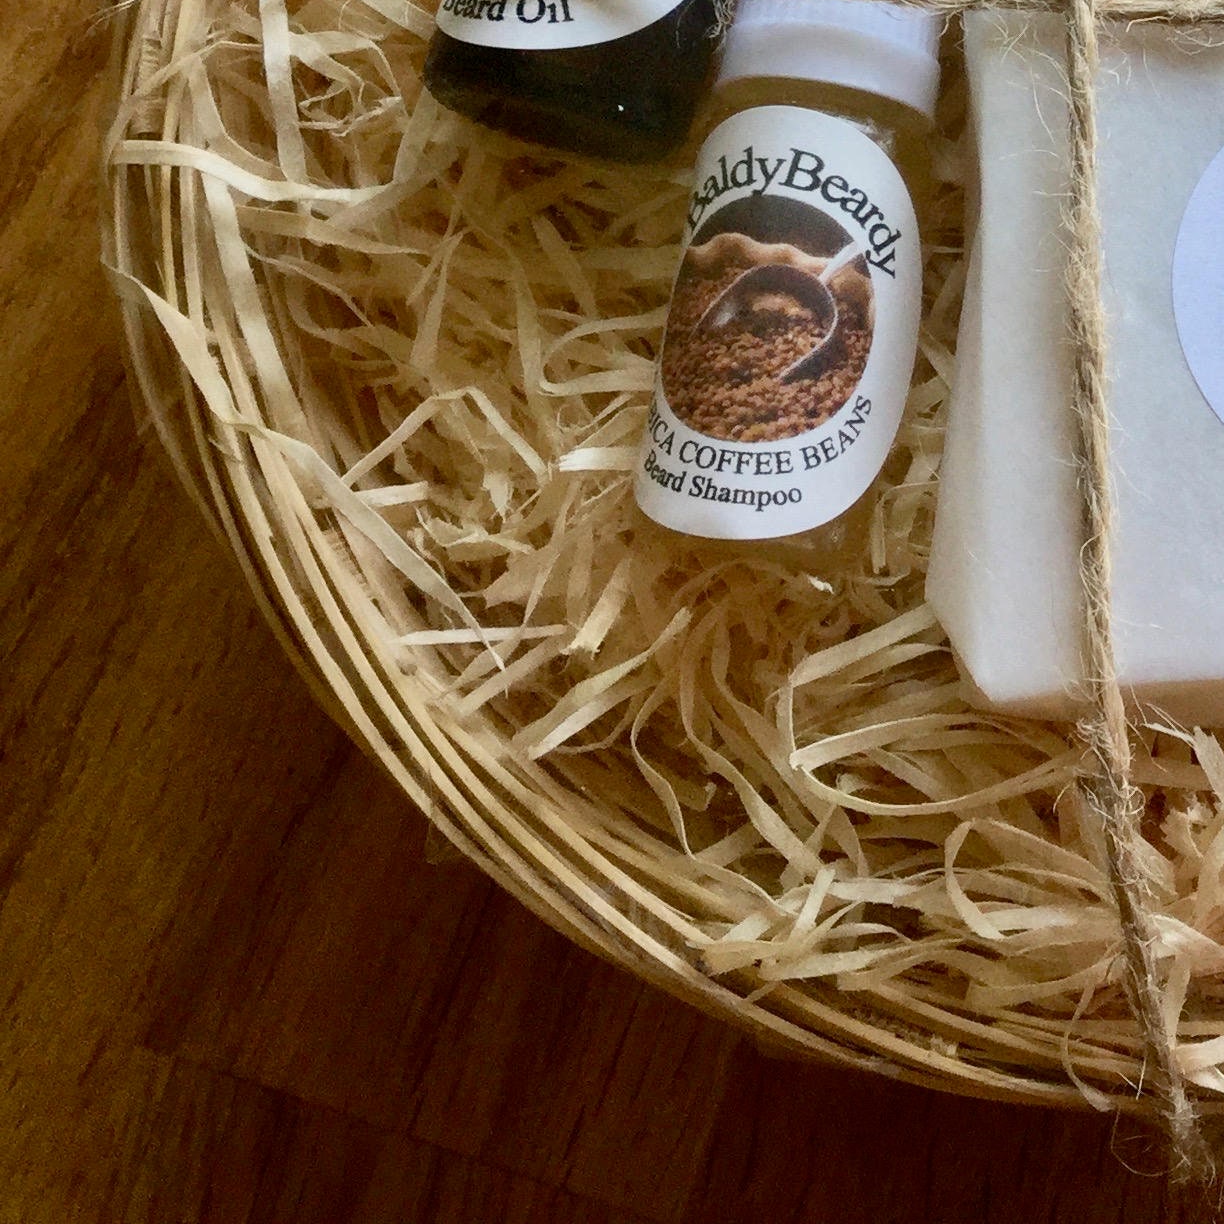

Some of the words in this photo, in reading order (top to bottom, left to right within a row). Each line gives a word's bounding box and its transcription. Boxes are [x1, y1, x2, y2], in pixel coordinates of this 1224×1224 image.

[679, 440, 794, 475] COFFEE
[800, 395, 873, 471] BEANS
[644, 449, 687, 493] Beard
[688, 475, 802, 512] Shampoo
